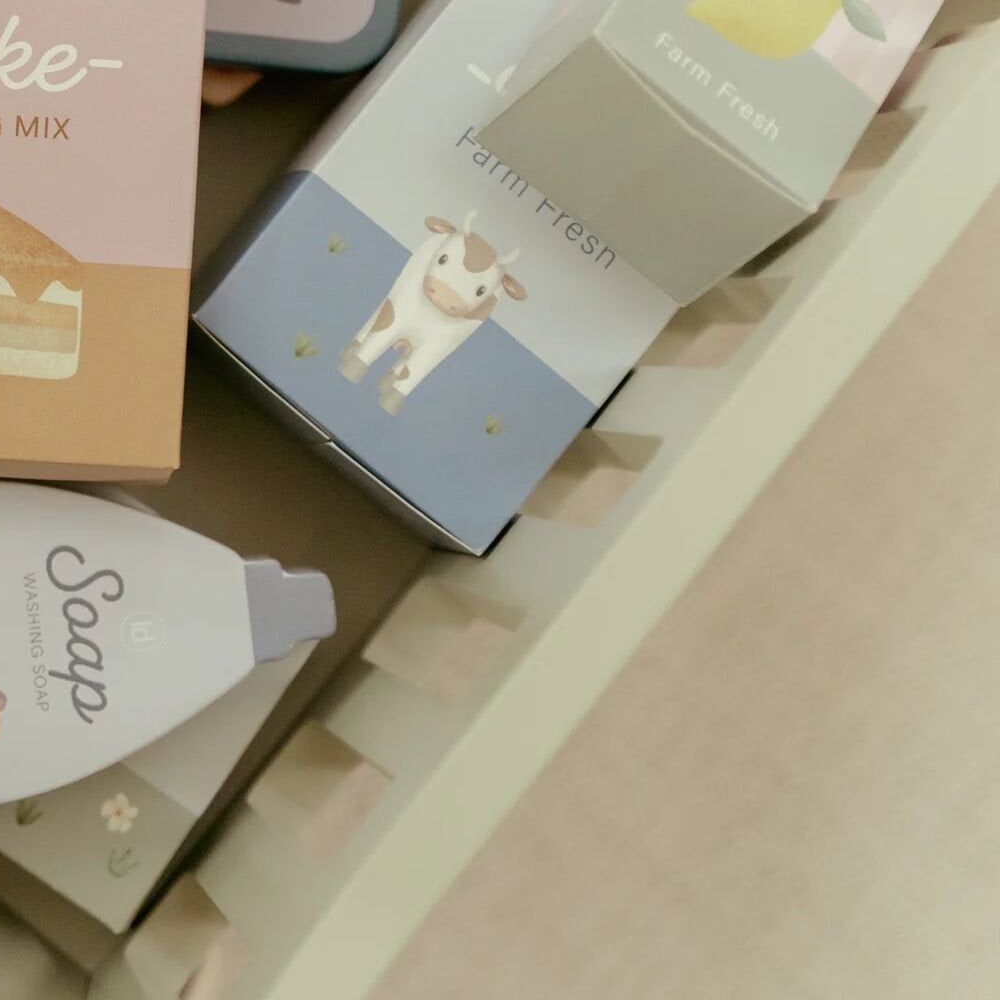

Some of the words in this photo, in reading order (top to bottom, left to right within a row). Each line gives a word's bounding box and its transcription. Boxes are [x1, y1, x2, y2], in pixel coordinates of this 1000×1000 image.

[15, 114, 72, 140] MIX
[654, 31, 713, 88] Farm
[716, 80, 780, 142] Fresh
[23, 571, 45, 659] WASHING
[46, 545, 125, 725] Soap
[31, 664, 50, 713] SOAP
